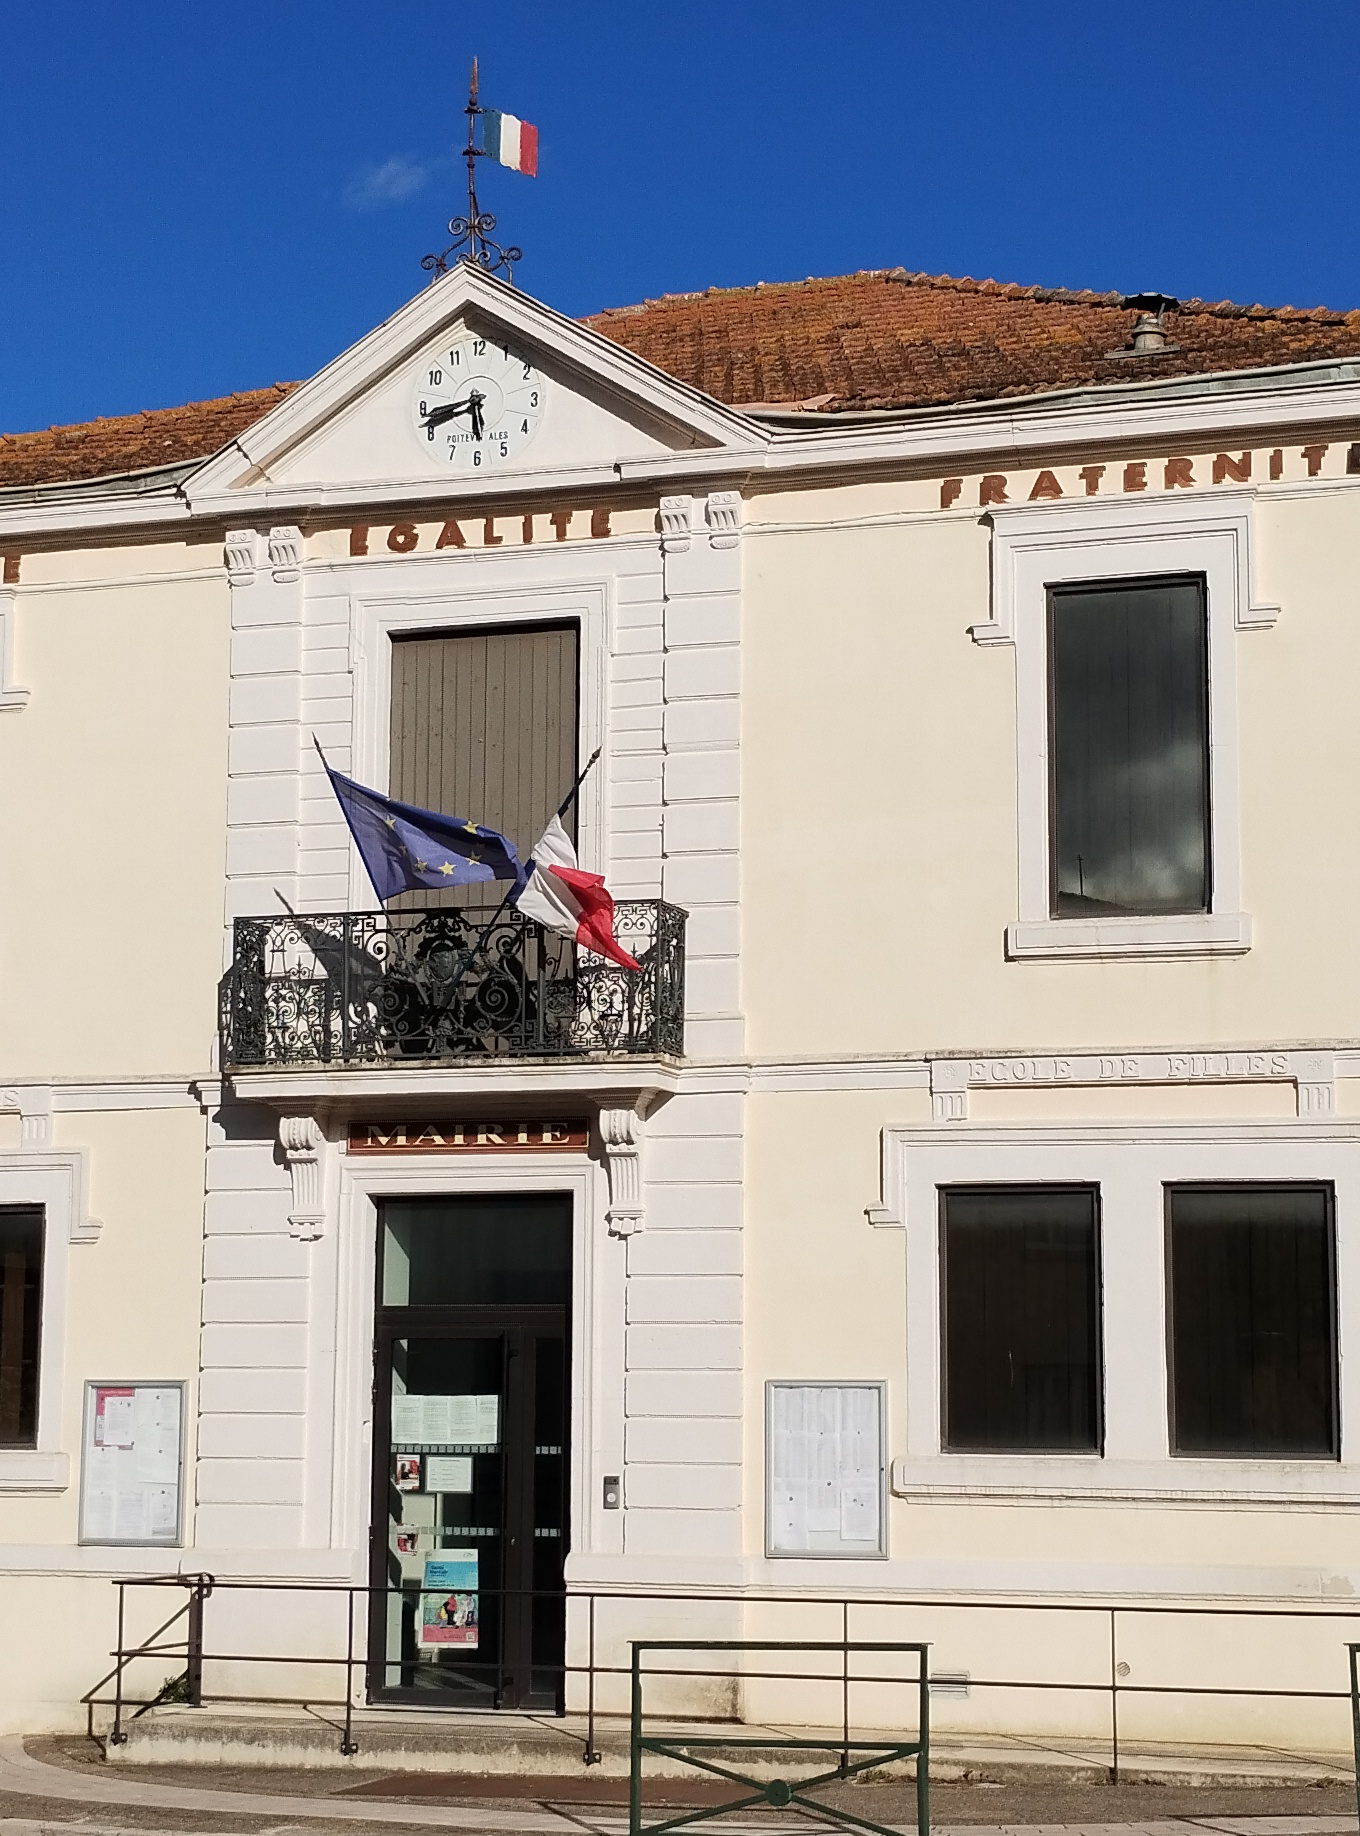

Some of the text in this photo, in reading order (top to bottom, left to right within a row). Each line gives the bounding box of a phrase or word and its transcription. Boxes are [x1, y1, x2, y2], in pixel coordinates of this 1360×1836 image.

[473, 341, 486, 356] 12
[502, 345, 509, 361] 1
[450, 351, 460, 366] 11
[428, 370, 442, 386] 10
[522, 363, 531, 381] 2
[530, 392, 538, 407] 3
[419, 401, 427, 416] 9
[427, 425, 434, 441] 8
[521, 419, 528, 434] 4
[489, 431, 508, 441] ALES
[448, 445, 456, 461] 7
[500, 442, 508, 457] 5
[474, 451, 481, 466] 6
[349, 508, 612, 556] EGALITE
[968, 1055, 1290, 1082] ECOLE DE FILLES
[363, 1122, 570, 1147] MAIRIE
